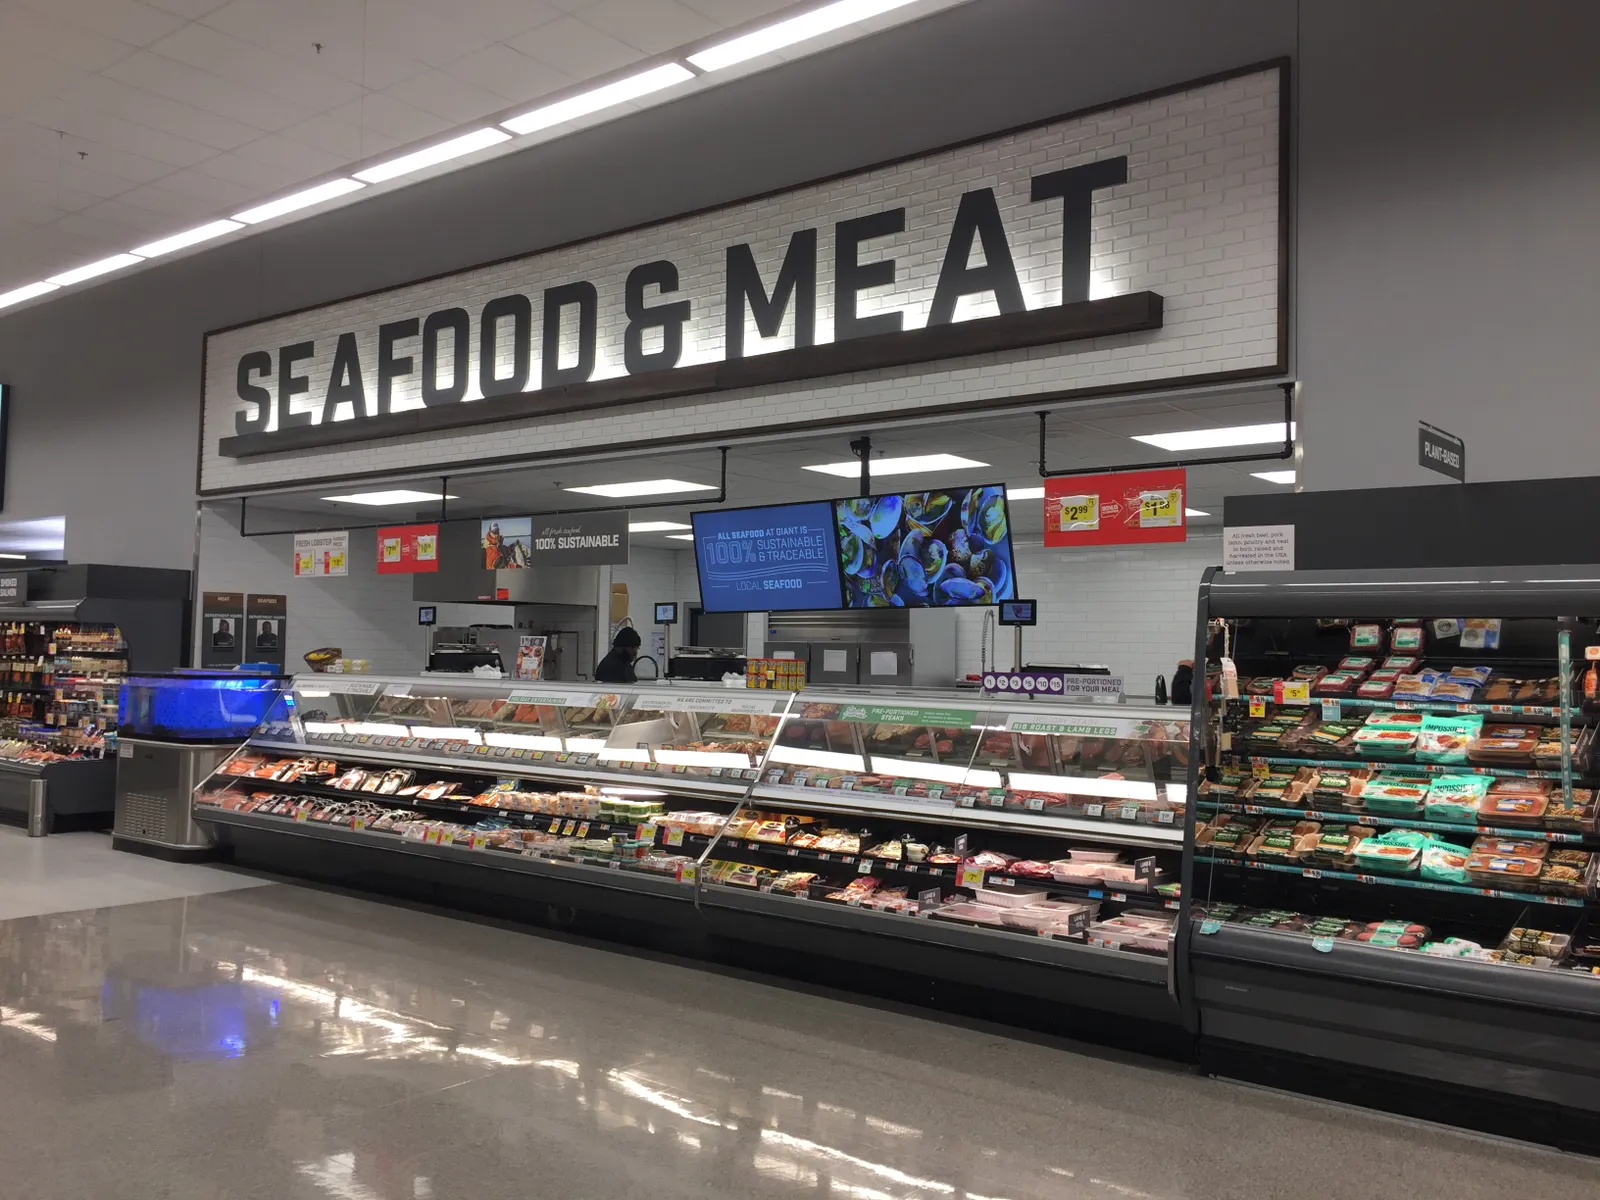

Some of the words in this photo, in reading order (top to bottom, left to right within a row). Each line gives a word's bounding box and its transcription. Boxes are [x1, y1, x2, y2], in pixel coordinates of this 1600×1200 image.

[235, 281, 598, 436] SEAFOOD
[624, 260, 691, 375] &
[725, 155, 1128, 360] MEAT
[1424, 441, 1460, 468] PLANT-BASED
[718, 532, 731, 540] ALL
[732, 529, 764, 539] SEAFOOD
[766, 528, 776, 536] AT
[776, 526, 798, 536] GIANT
[800, 526, 808, 534] IS
[311, 538, 331, 547] LOBSTER
[535, 538, 556, 550] 100%
[558, 534, 619, 549] SUSTAINABLE
[757, 535, 823, 550] SUSTAINABLE
[706, 540, 757, 564] 100%
[759, 551, 765, 562] &
[767, 548, 824, 561] TRACEABLE
[736, 580, 762, 591] LOCAL
[763, 579, 802, 590] SEAFOOD
[1066, 678, 1122, 686] PRE-PORTIONED
[1081, 685, 1100, 693] YOUR
[871, 707, 920, 717] PRE-PORTIONED
[1013, 722, 1026, 730] RIB
[1067, 726, 1091, 734] LAMB
[1093, 727, 1117, 736] LEGS
